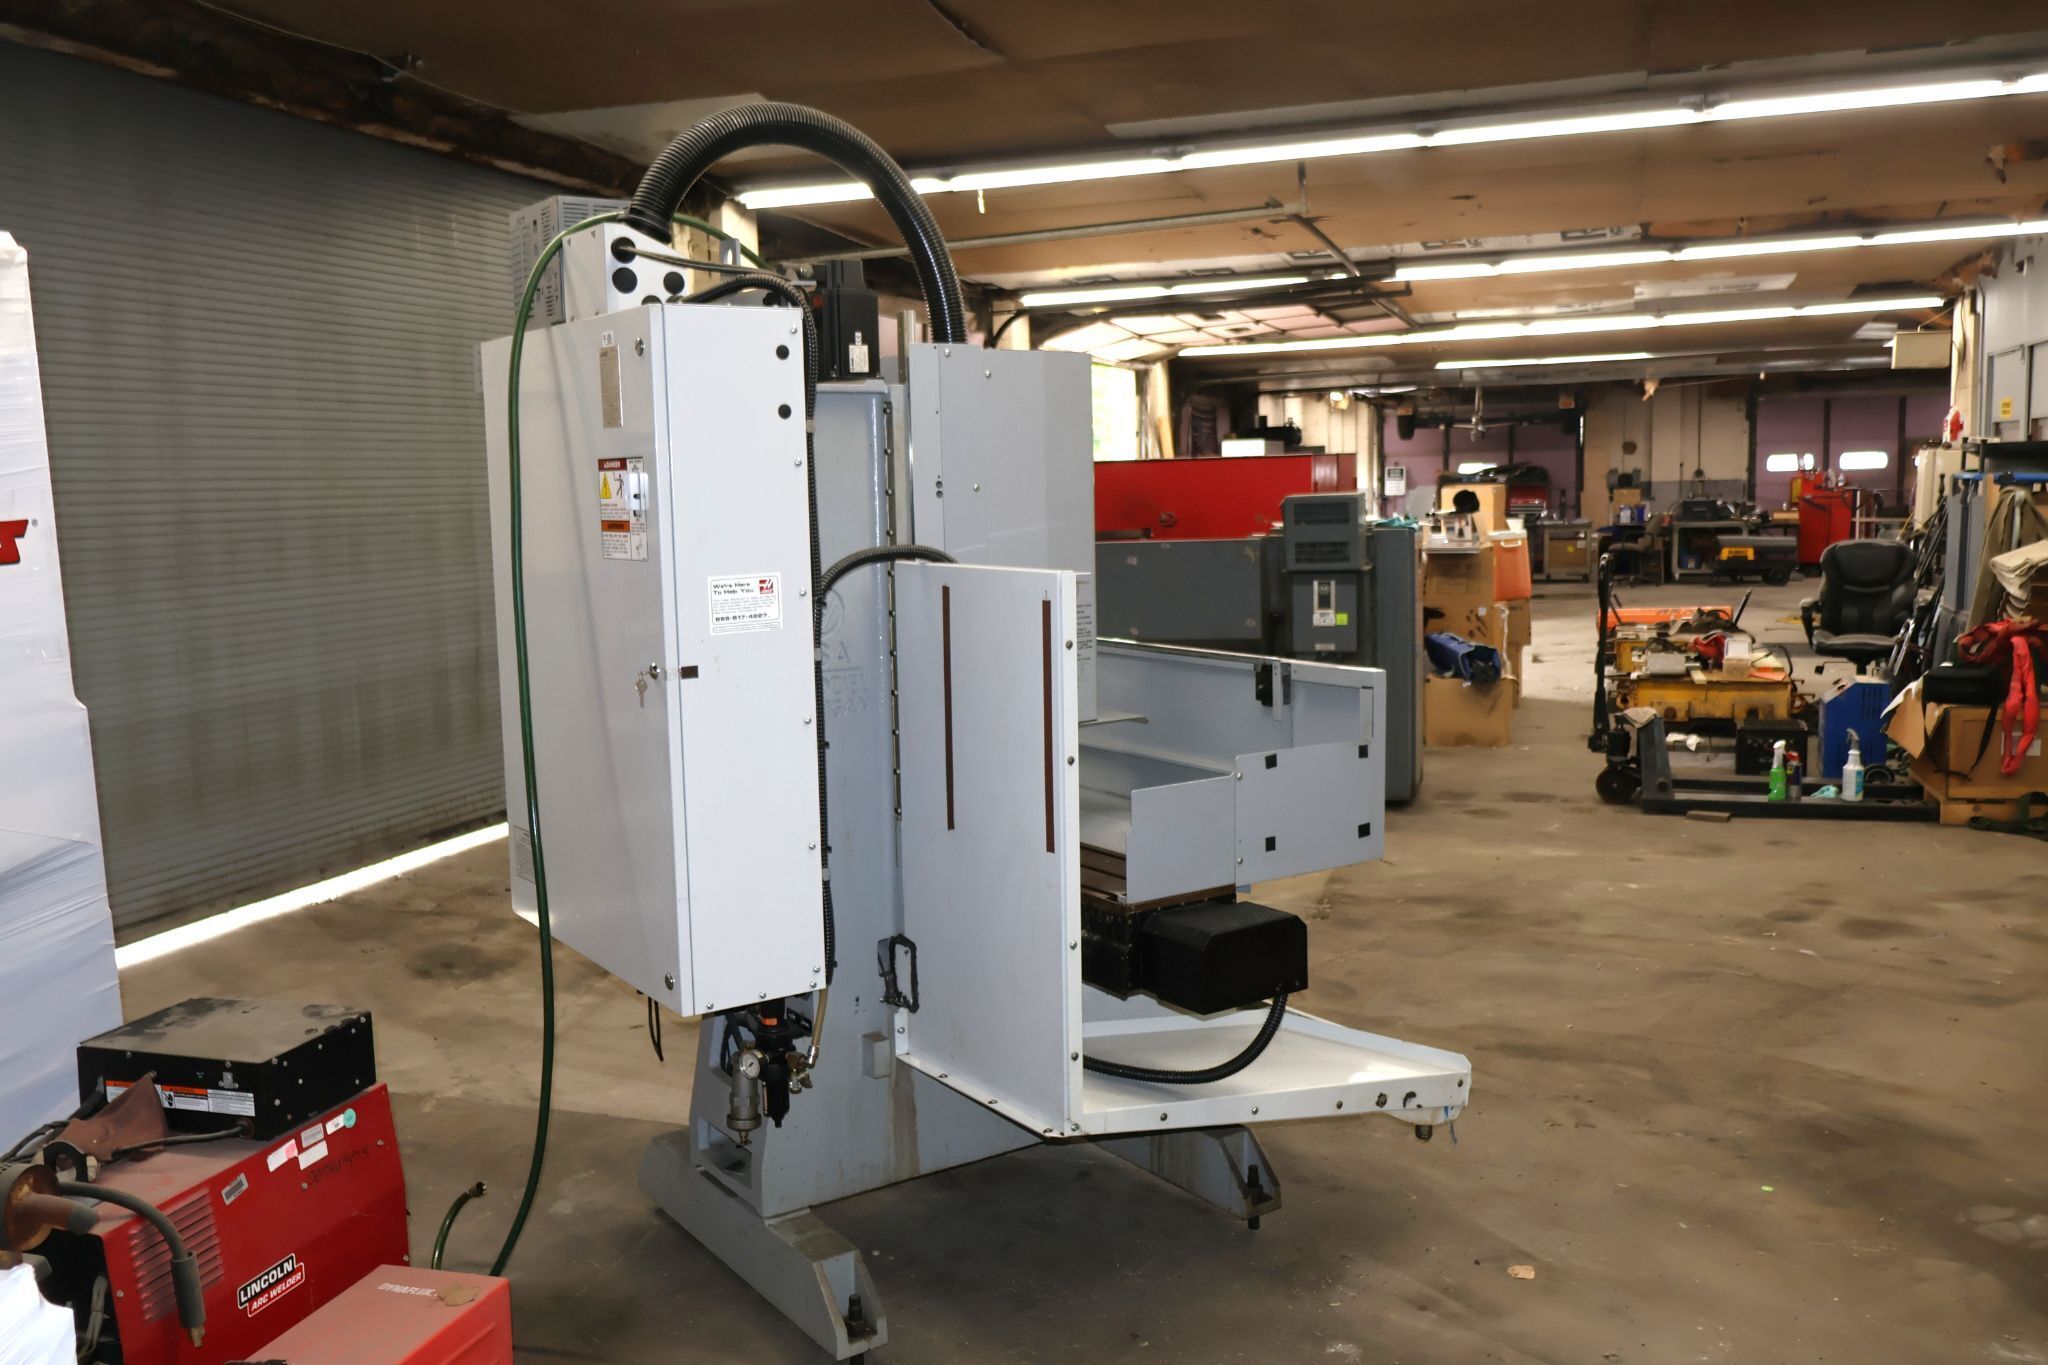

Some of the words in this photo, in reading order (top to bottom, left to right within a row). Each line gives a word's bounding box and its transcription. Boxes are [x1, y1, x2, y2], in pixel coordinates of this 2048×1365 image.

[240, 1258, 293, 1303] LINCOLN
[251, 1293, 269, 1312] ARC
[269, 1271, 302, 1299] WELDER
